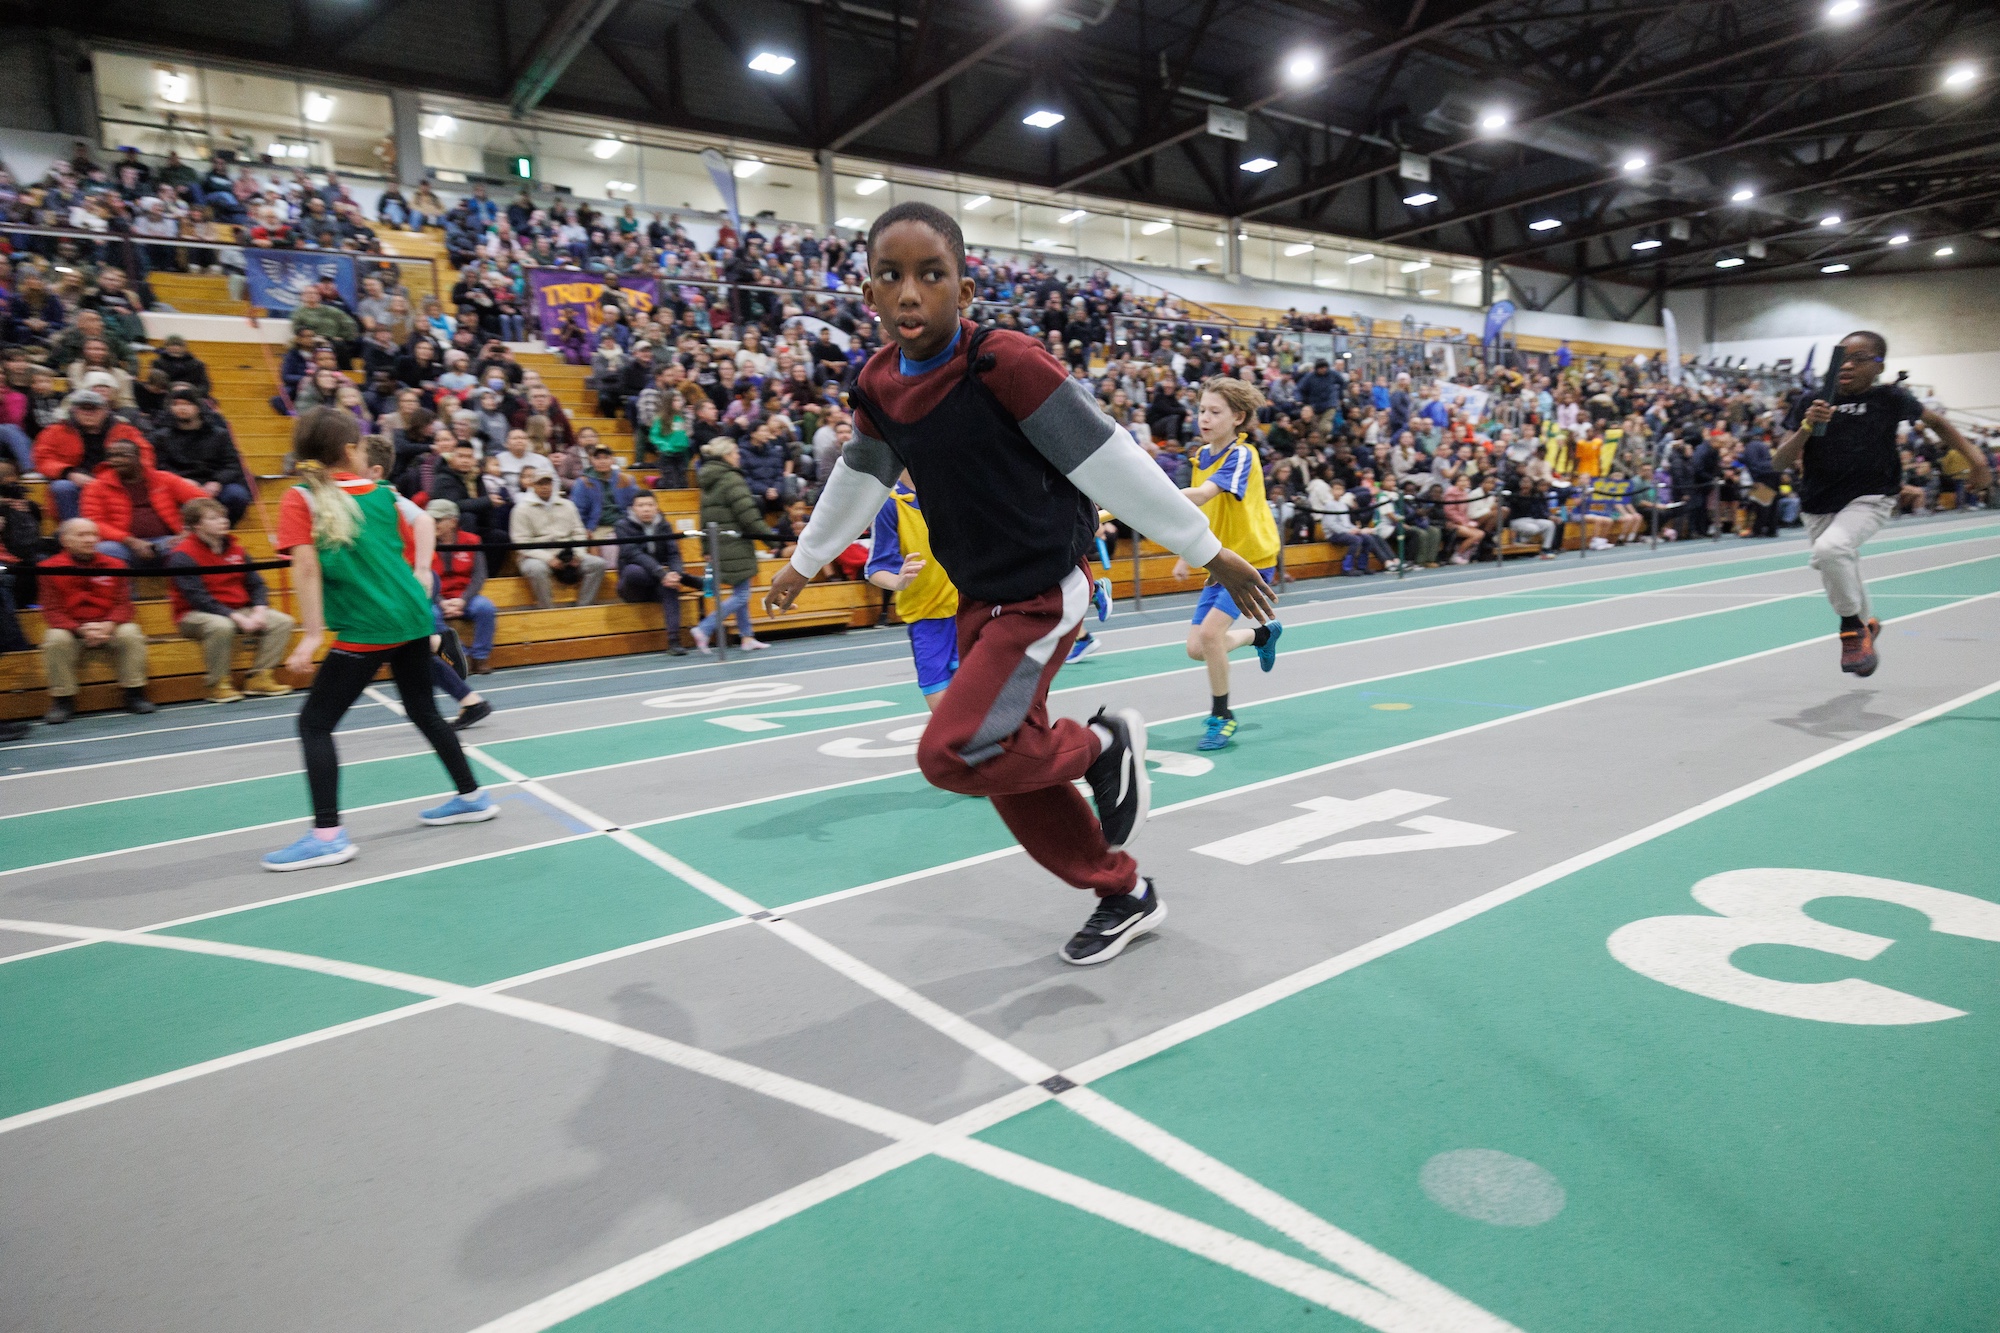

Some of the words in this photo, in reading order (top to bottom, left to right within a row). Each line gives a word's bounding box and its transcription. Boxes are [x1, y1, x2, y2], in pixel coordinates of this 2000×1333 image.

[641, 682, 804, 708] 8
[704, 700, 900, 732] 7
[1188, 788, 1518, 866] 4
[1607, 866, 2000, 1026] 3
